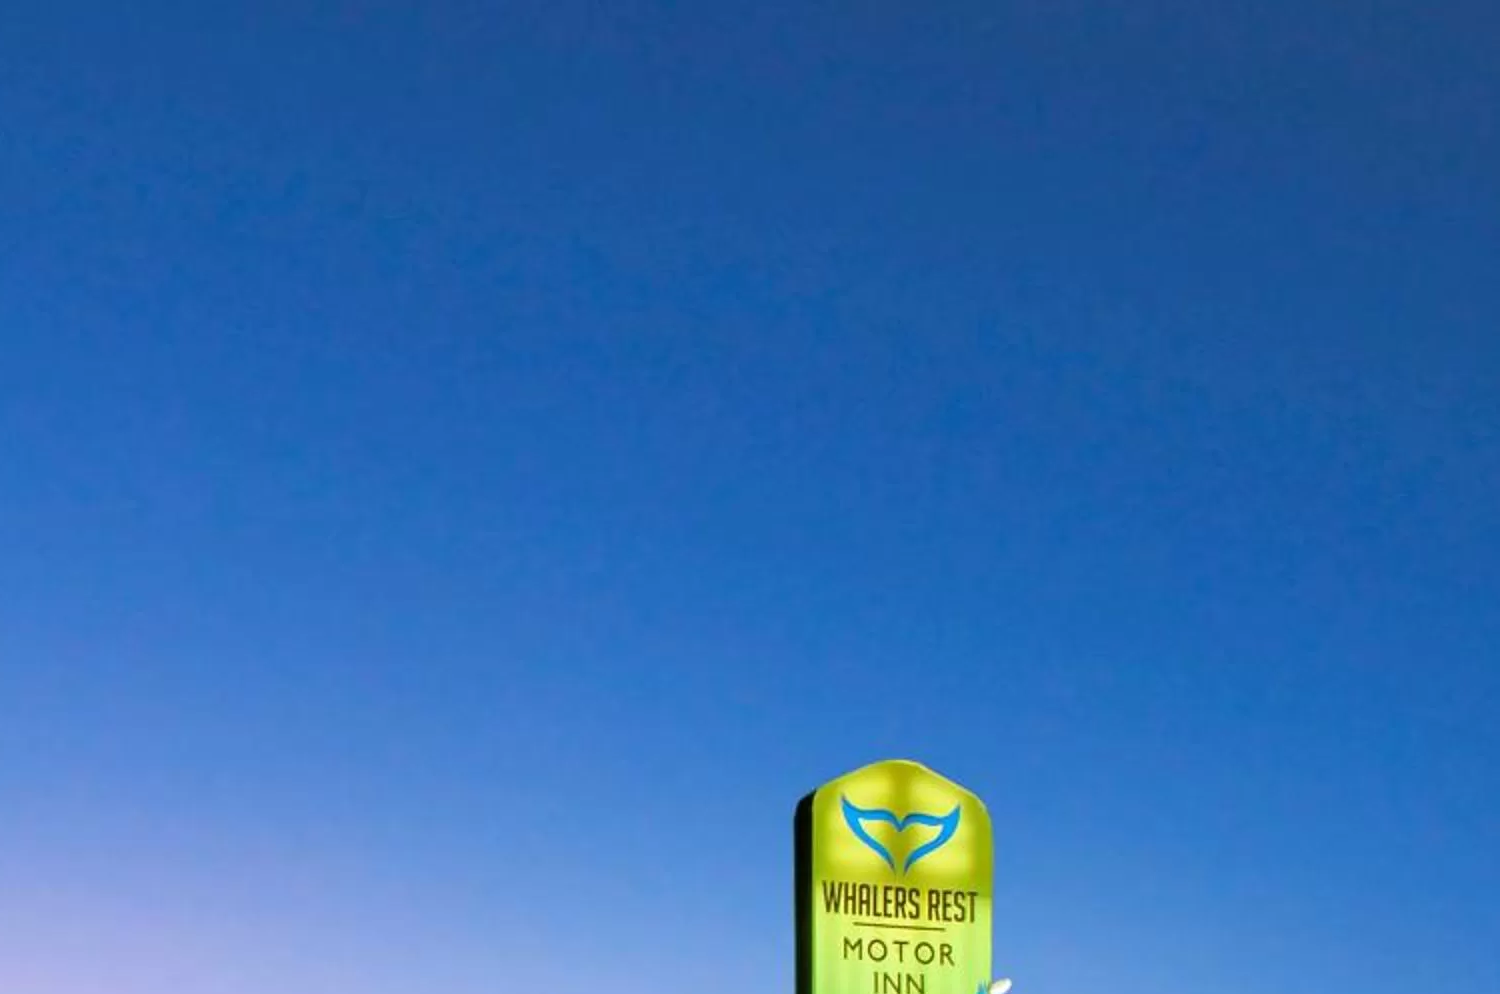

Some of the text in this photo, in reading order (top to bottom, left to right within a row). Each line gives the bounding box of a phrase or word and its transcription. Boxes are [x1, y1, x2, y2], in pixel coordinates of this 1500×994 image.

[822, 880, 978, 923] WHALERS REST
[843, 936, 955, 966] MOTOR
